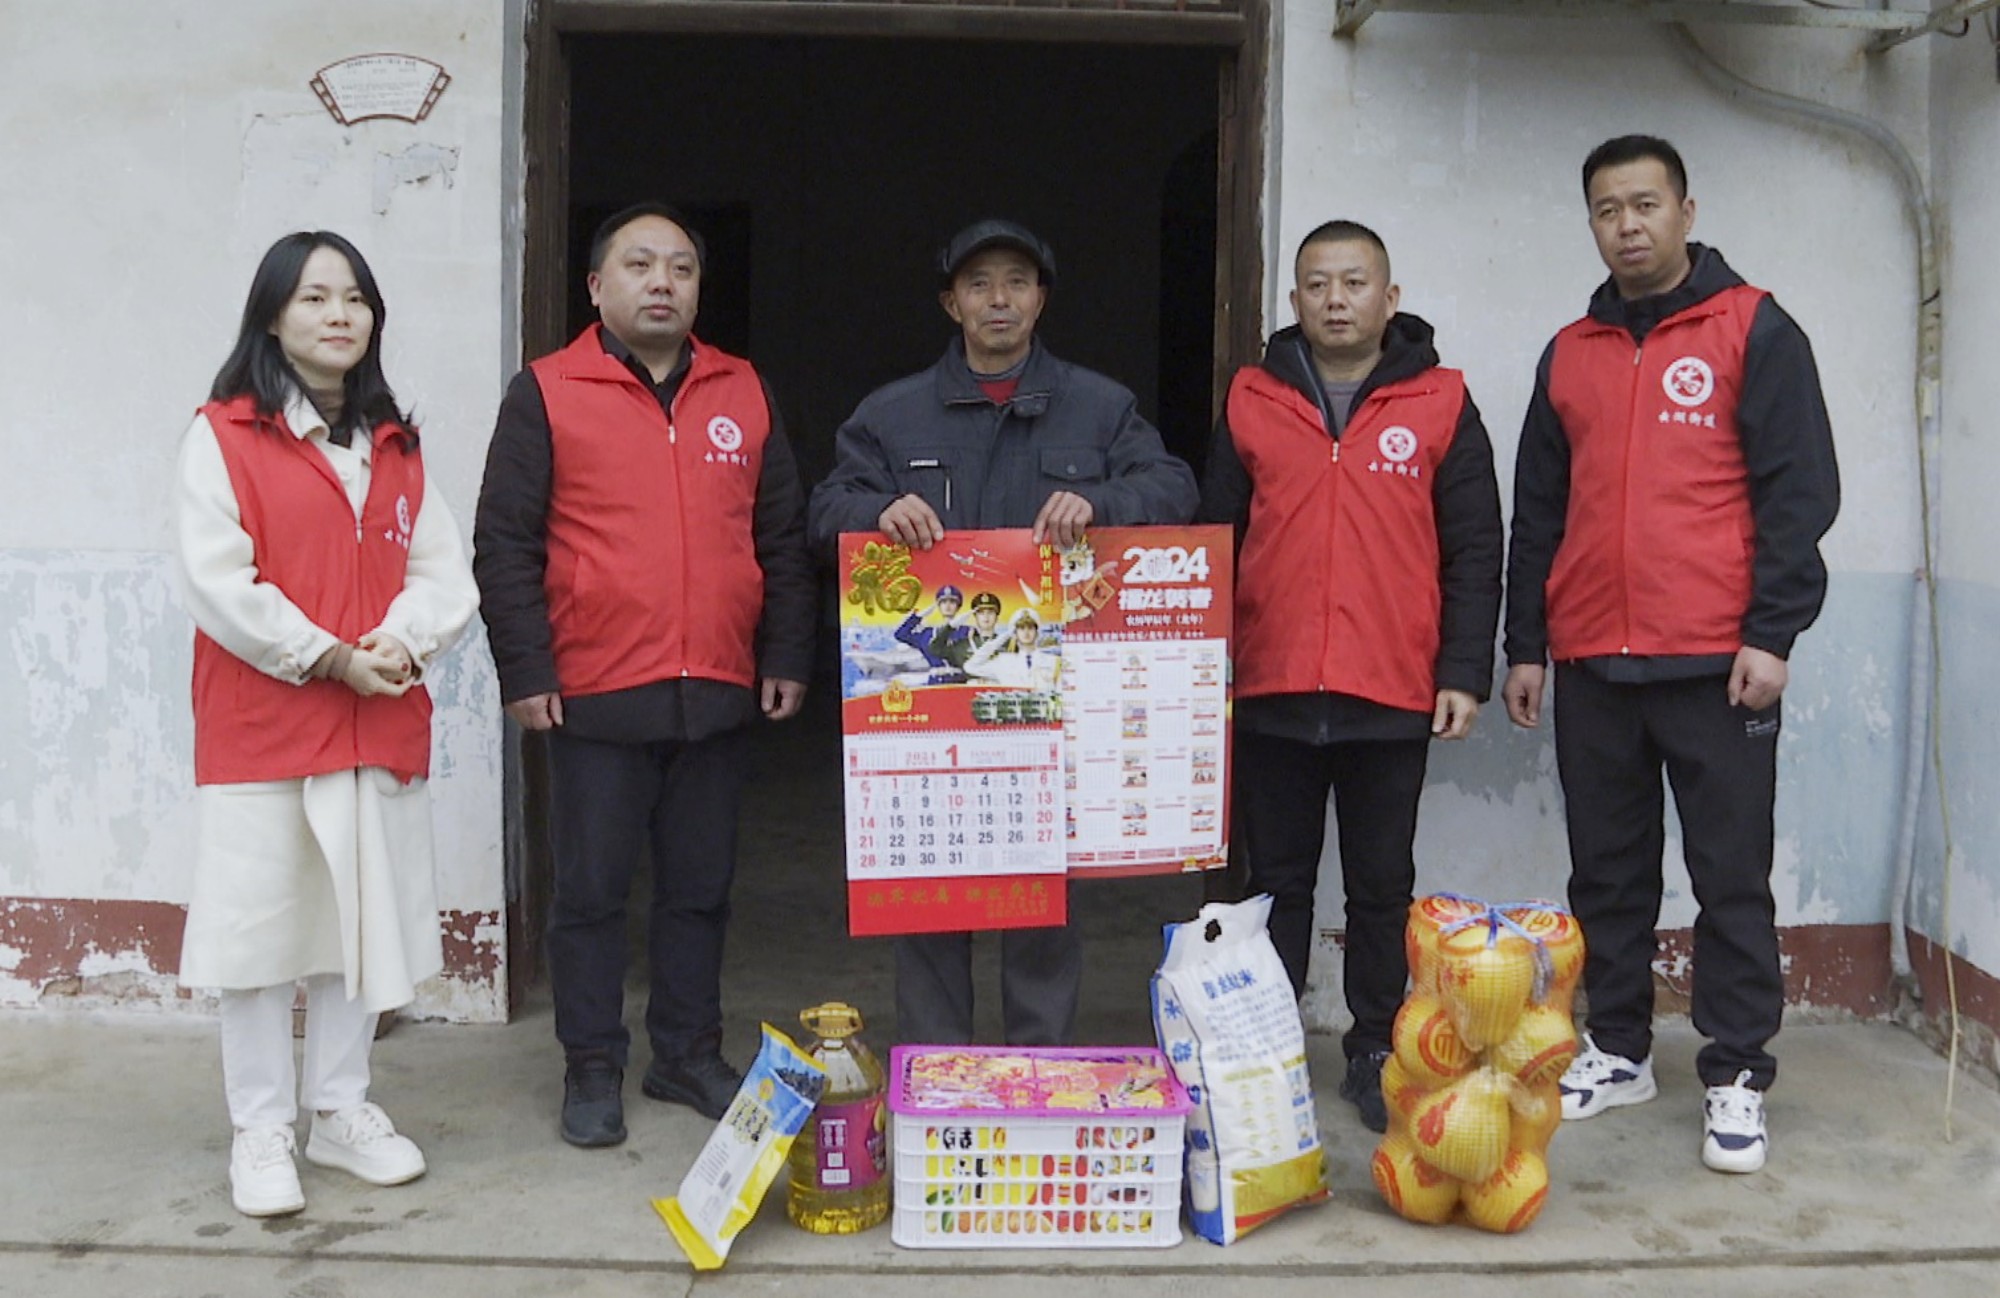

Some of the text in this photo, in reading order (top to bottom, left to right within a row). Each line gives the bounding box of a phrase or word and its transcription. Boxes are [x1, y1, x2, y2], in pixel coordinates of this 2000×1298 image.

[1122, 545, 1210, 584] 2024
[945, 744, 958, 767] 1
[892, 772, 1048, 789] 1 2 3 4 5 6
[863, 791, 1052, 809] 7 8 9 10 11 12 13
[860, 810, 1053, 829] 14 15 16 17 18 19 20
[860, 829, 1052, 848] 21 22 23 24 25 26 27
[860, 851, 963, 868] 28 29 30 31
